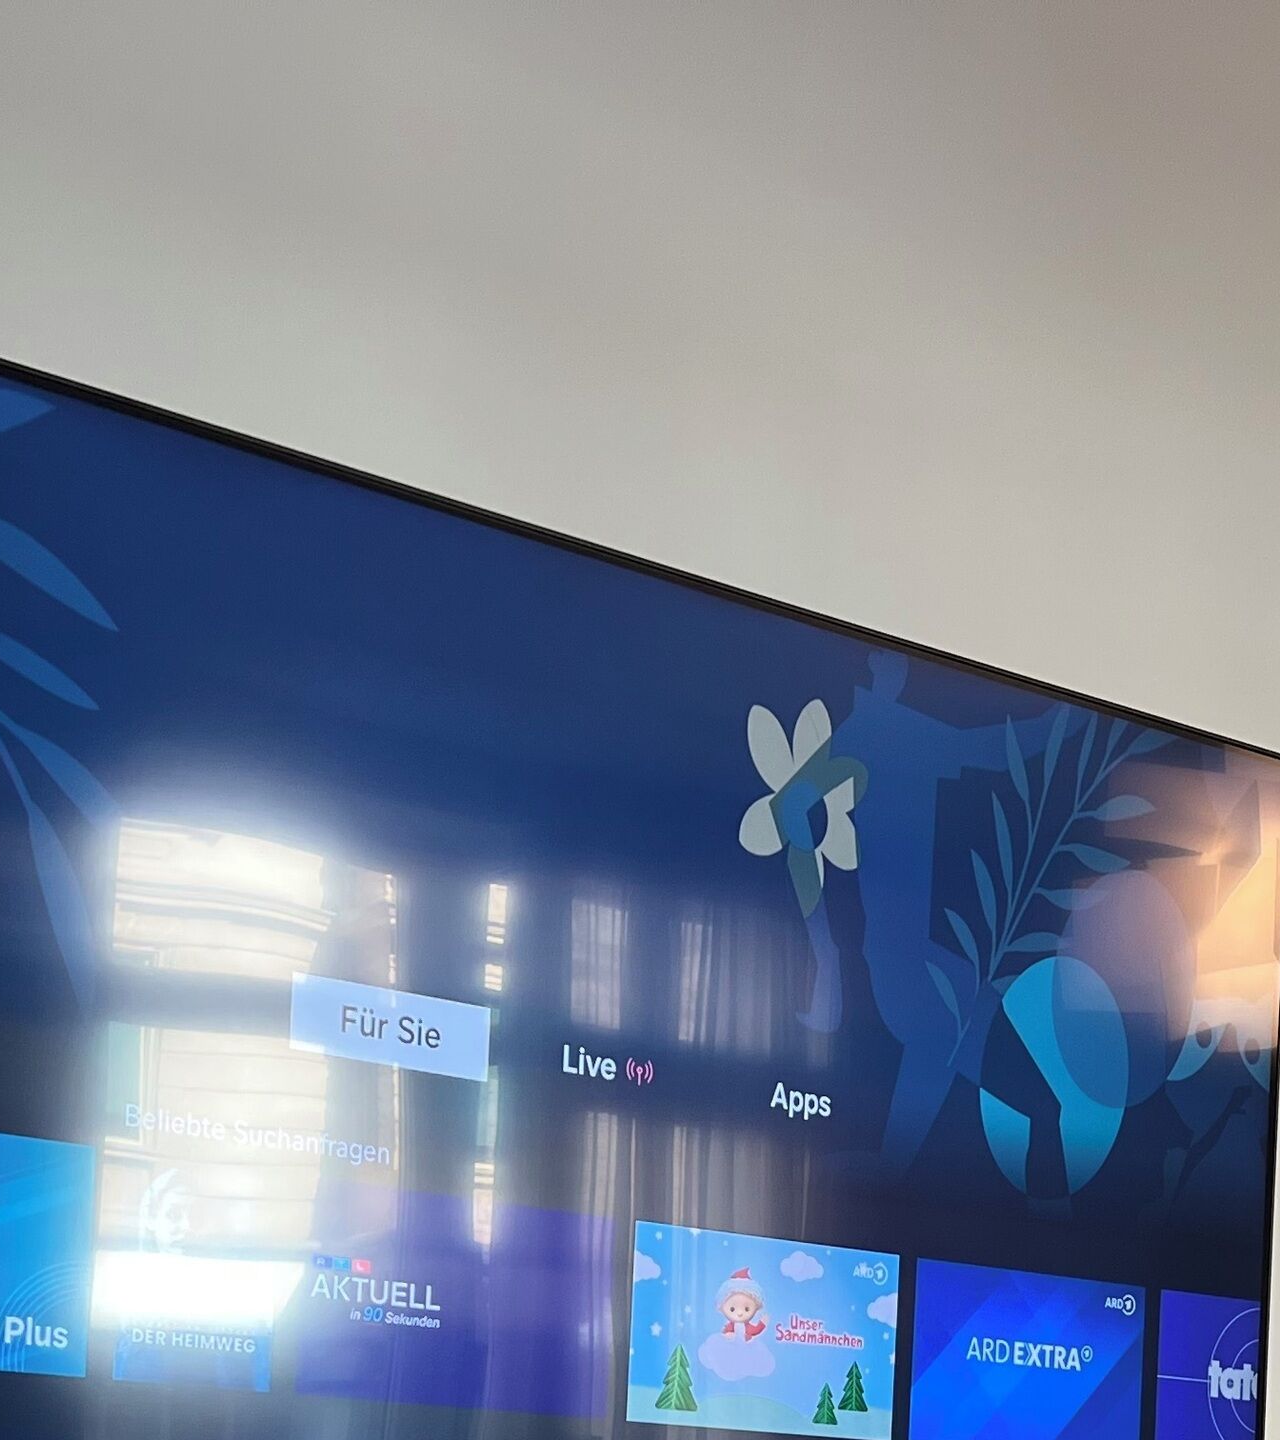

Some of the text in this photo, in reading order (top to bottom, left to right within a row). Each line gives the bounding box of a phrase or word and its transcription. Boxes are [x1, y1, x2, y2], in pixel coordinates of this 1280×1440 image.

[340, 1005, 441, 1049] Für Sie
[562, 1044, 617, 1080] Live
[770, 1082, 831, 1118] Apps
[125, 1103, 390, 1166] Beliebte Suchanfragen
[310, 1273, 441, 1311] AKTUELL
[4, 1315, 68, 1349] Plus
[350, 1306, 441, 1329] in 90 Sekunden
[790, 1315, 823, 1331] Unser
[132, 1327, 257, 1353] DER HEIMWEG
[966, 1336, 1011, 1364] ARD
